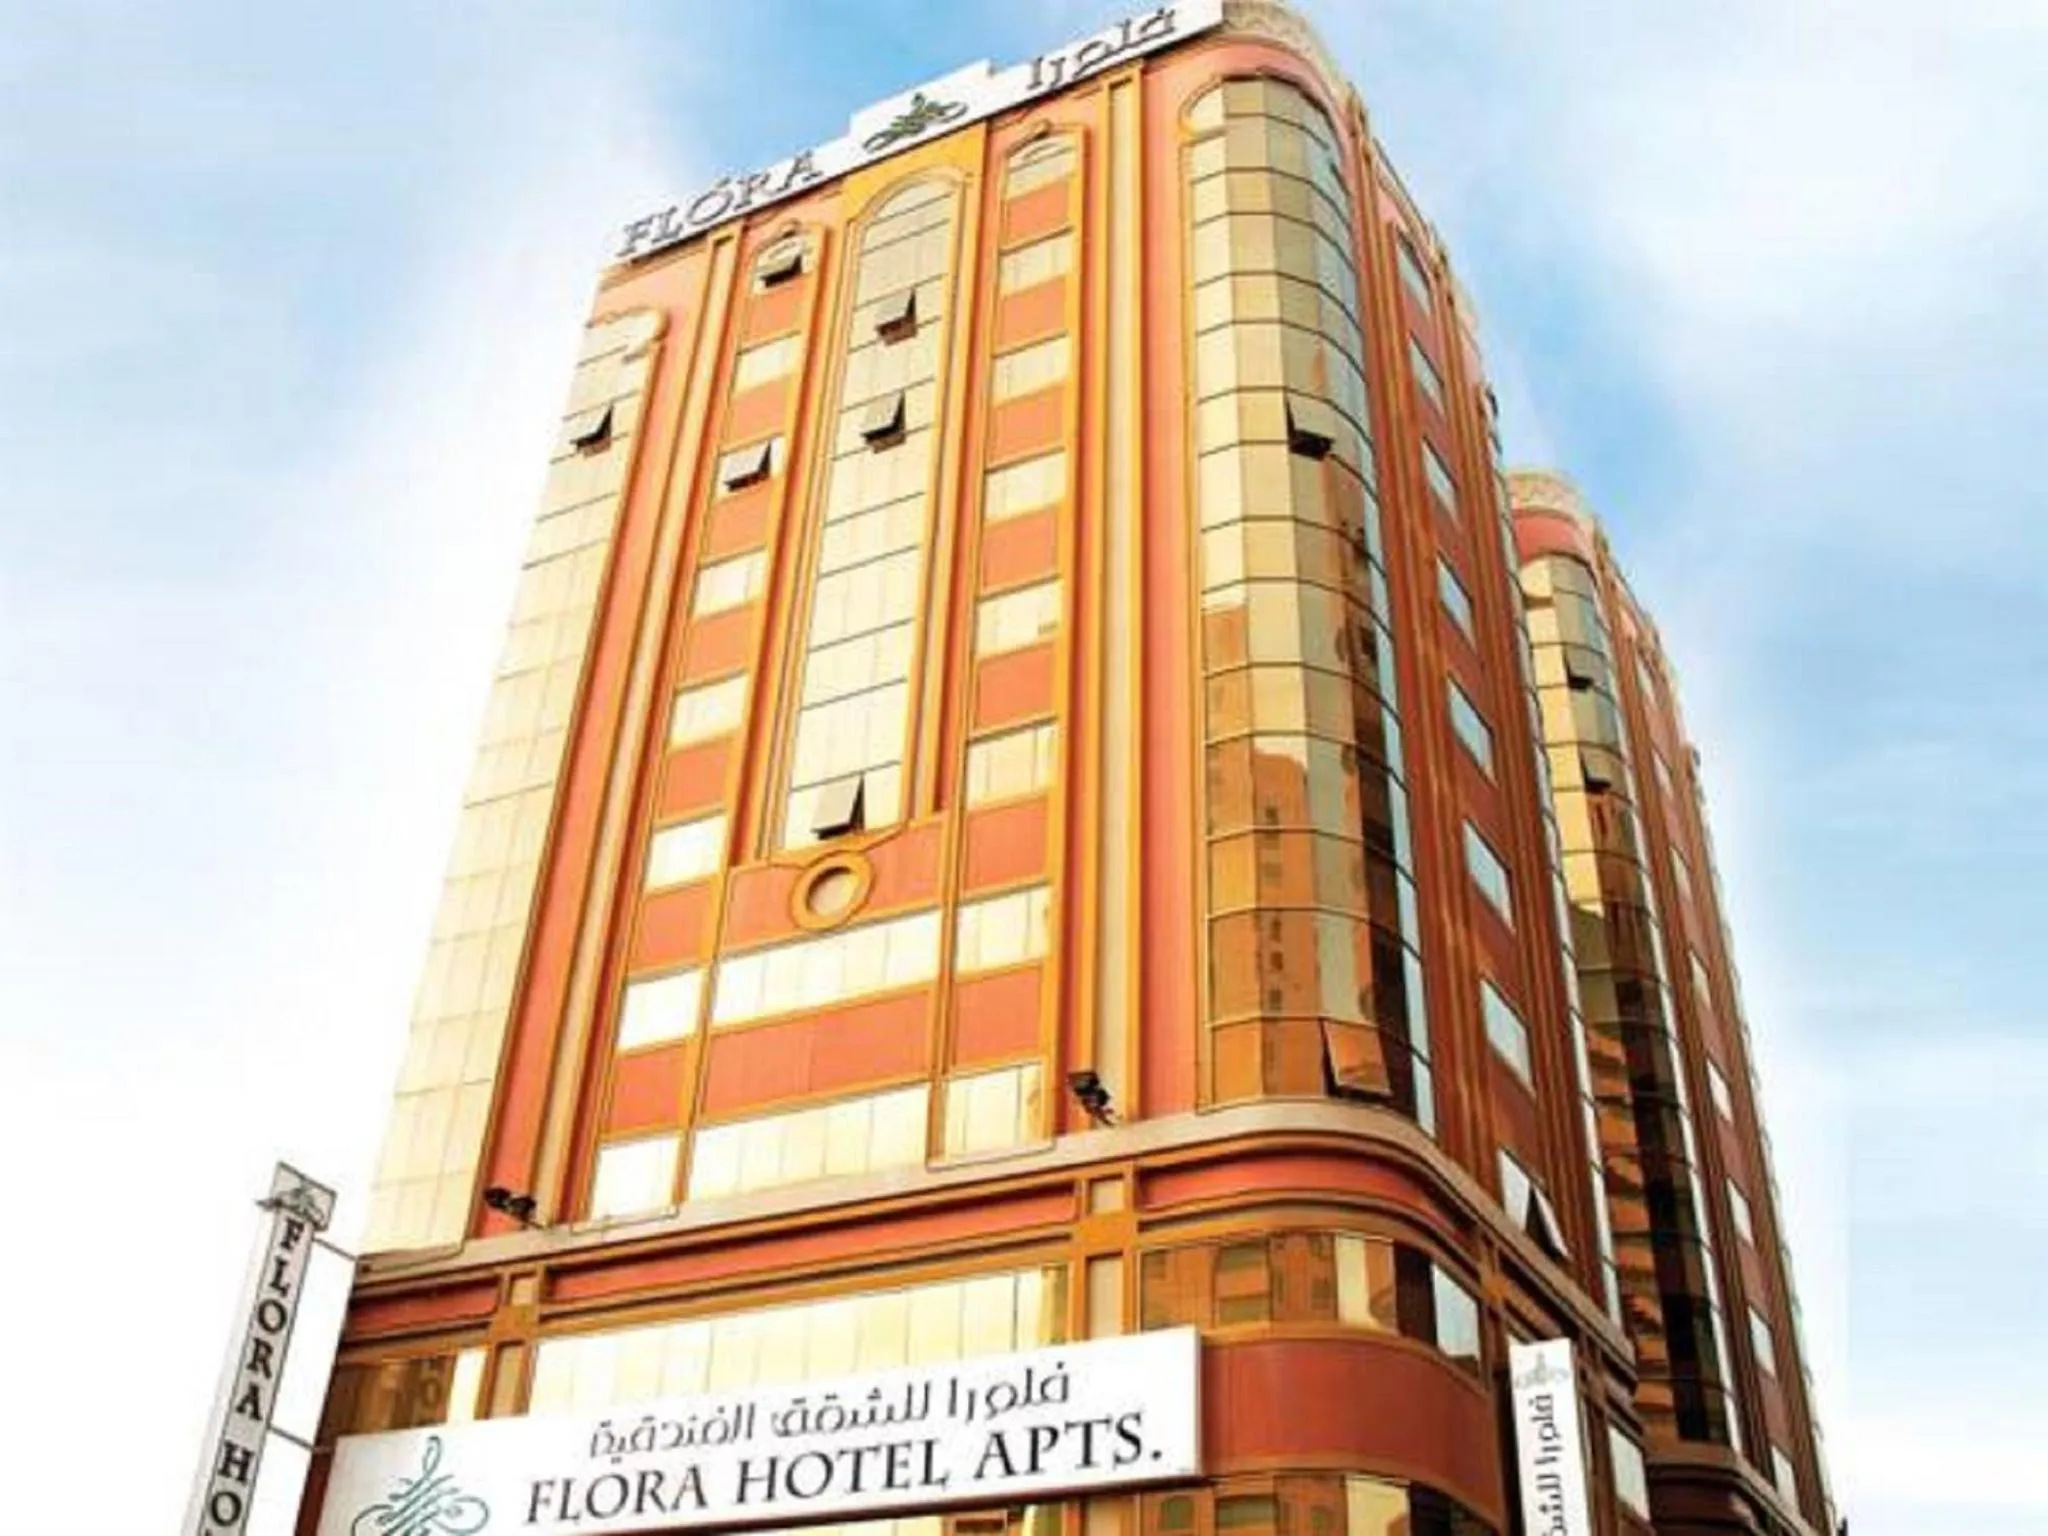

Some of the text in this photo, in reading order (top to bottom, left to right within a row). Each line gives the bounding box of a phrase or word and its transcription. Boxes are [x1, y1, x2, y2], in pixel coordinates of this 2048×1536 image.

[1026, 7, 1176, 90] فلورا
[204, 1216, 304, 1536] FLORA HO
[589, 1361, 1069, 1464] فلورا للشقق الفندقية
[522, 1410, 1162, 1526] FLORA HOTEL APTS.
